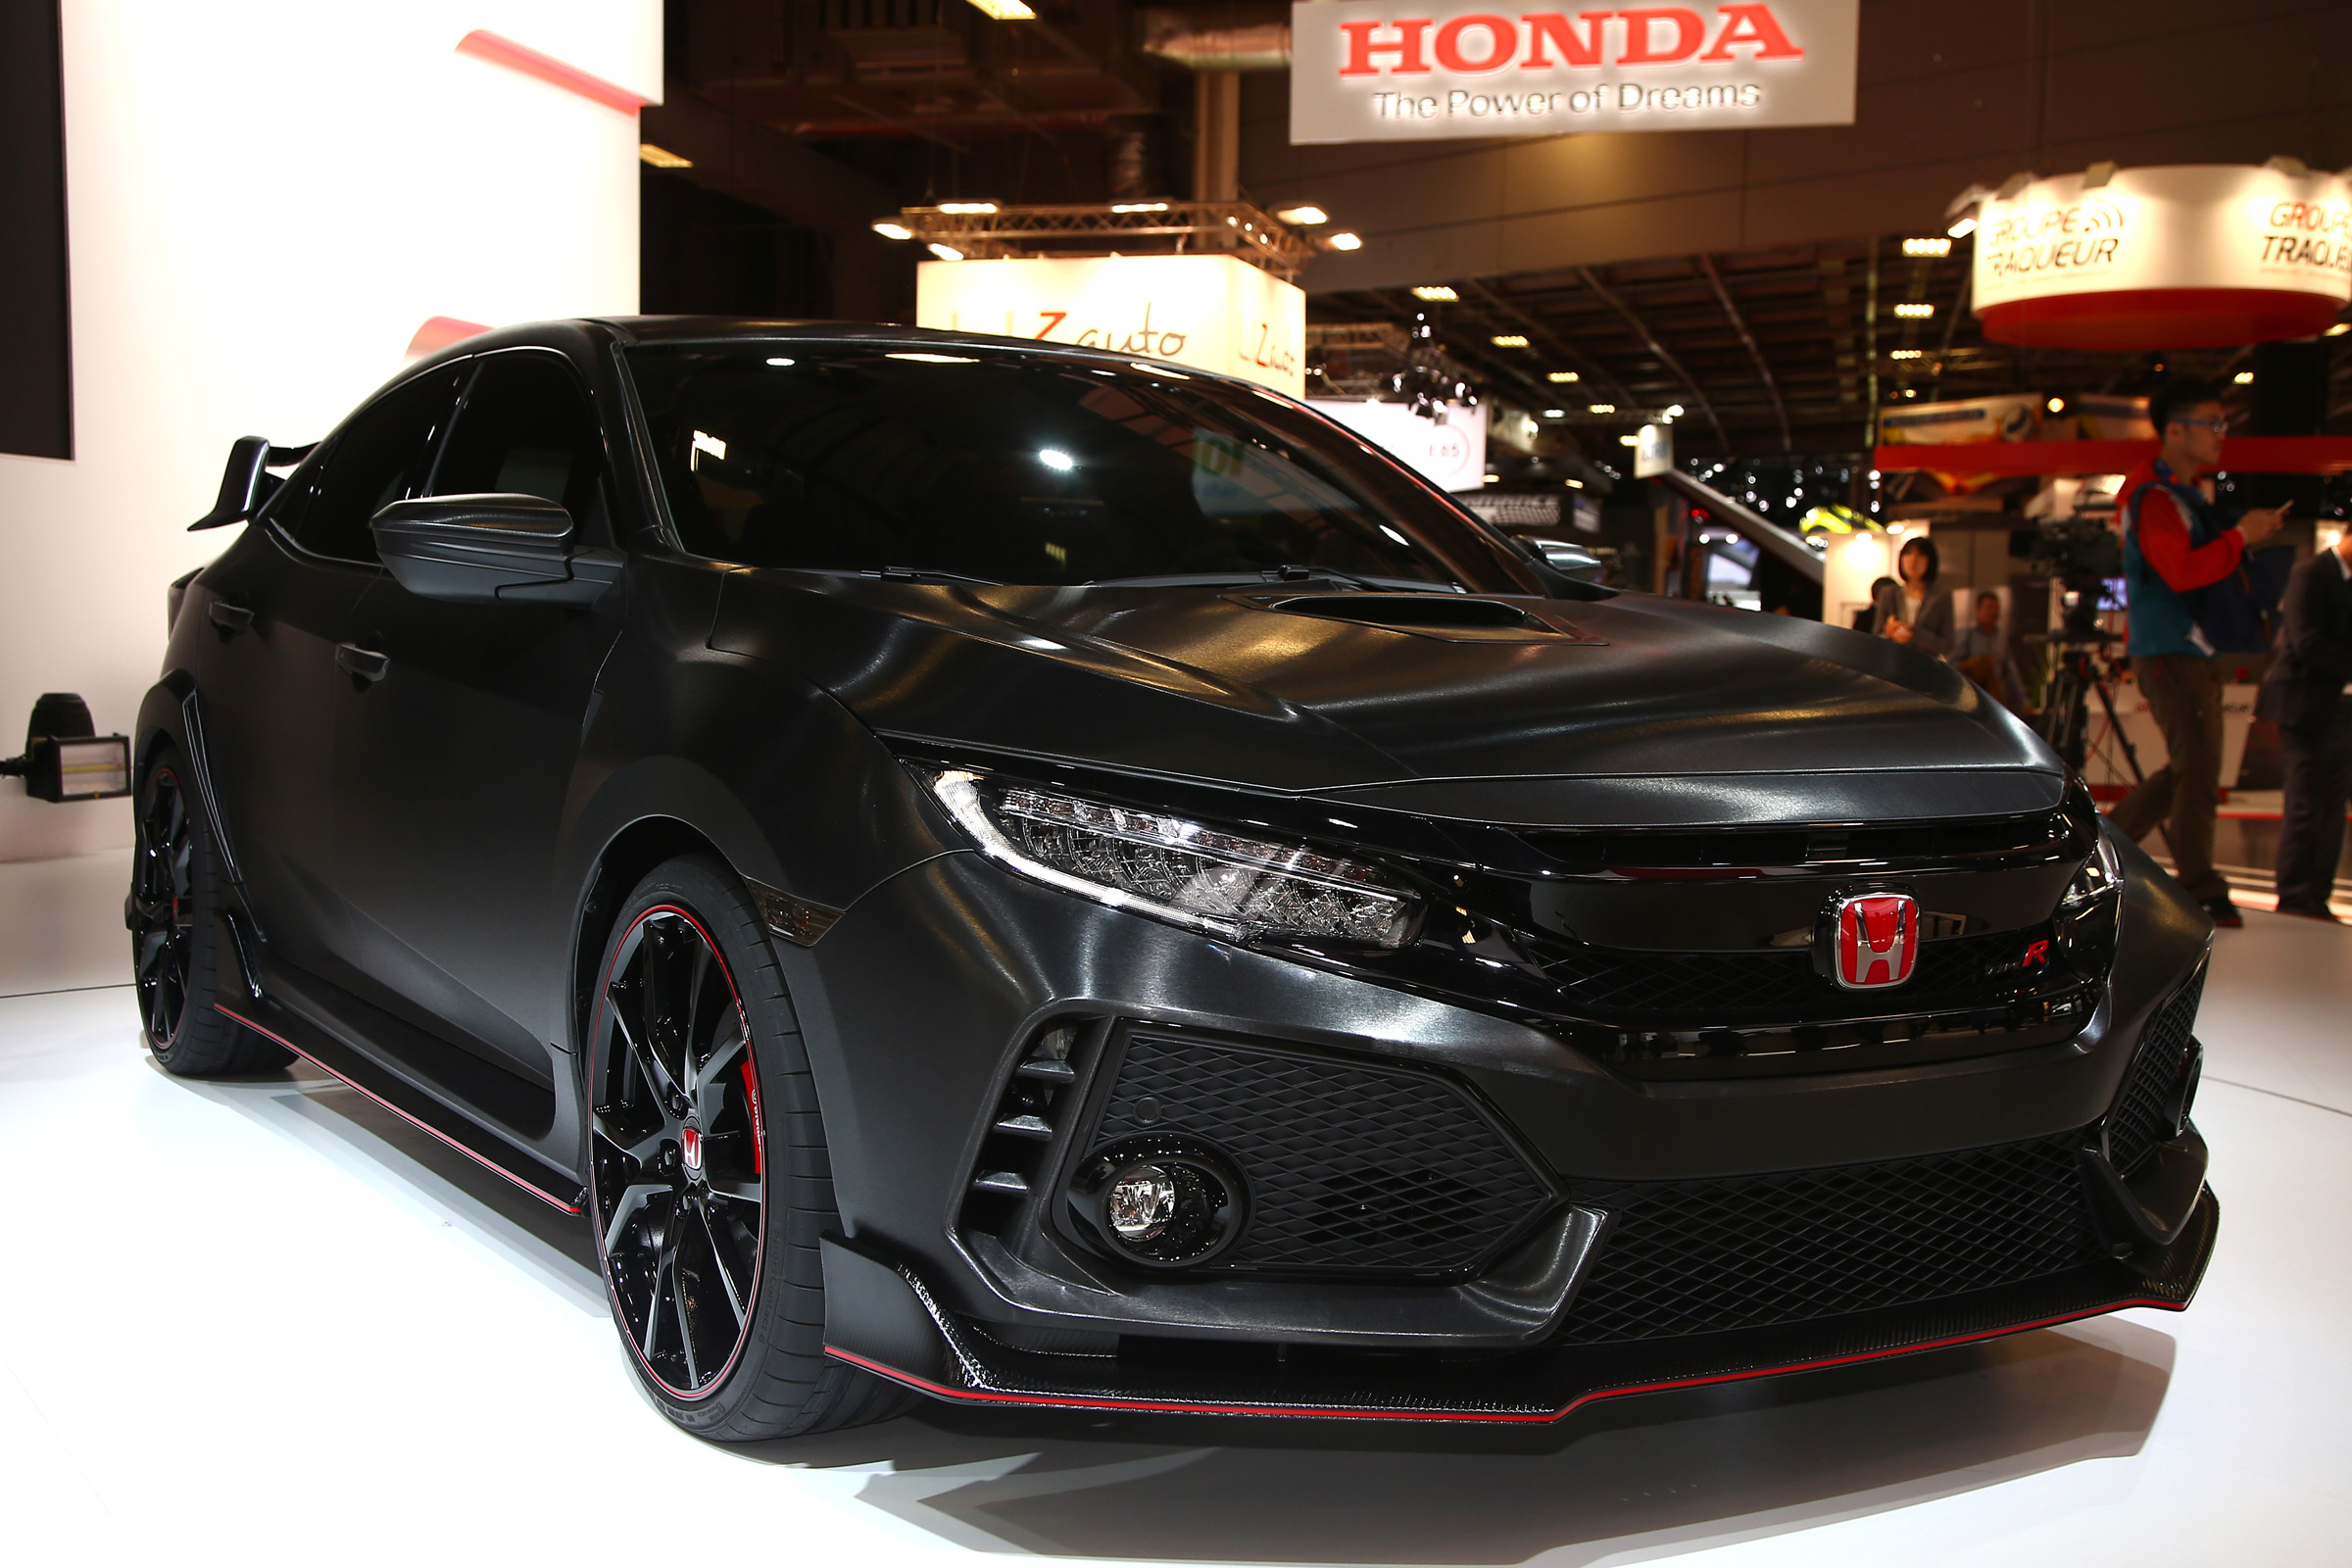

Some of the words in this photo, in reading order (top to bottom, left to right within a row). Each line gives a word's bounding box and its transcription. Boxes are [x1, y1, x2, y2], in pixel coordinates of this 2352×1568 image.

[1339, 4, 1804, 77] HONDA
[1374, 89, 1438, 120] The
[1447, 88, 1562, 118] Power
[1569, 83, 1608, 111] of
[1618, 80, 1761, 110] Dreams
[2022, 939, 2050, 967] R
